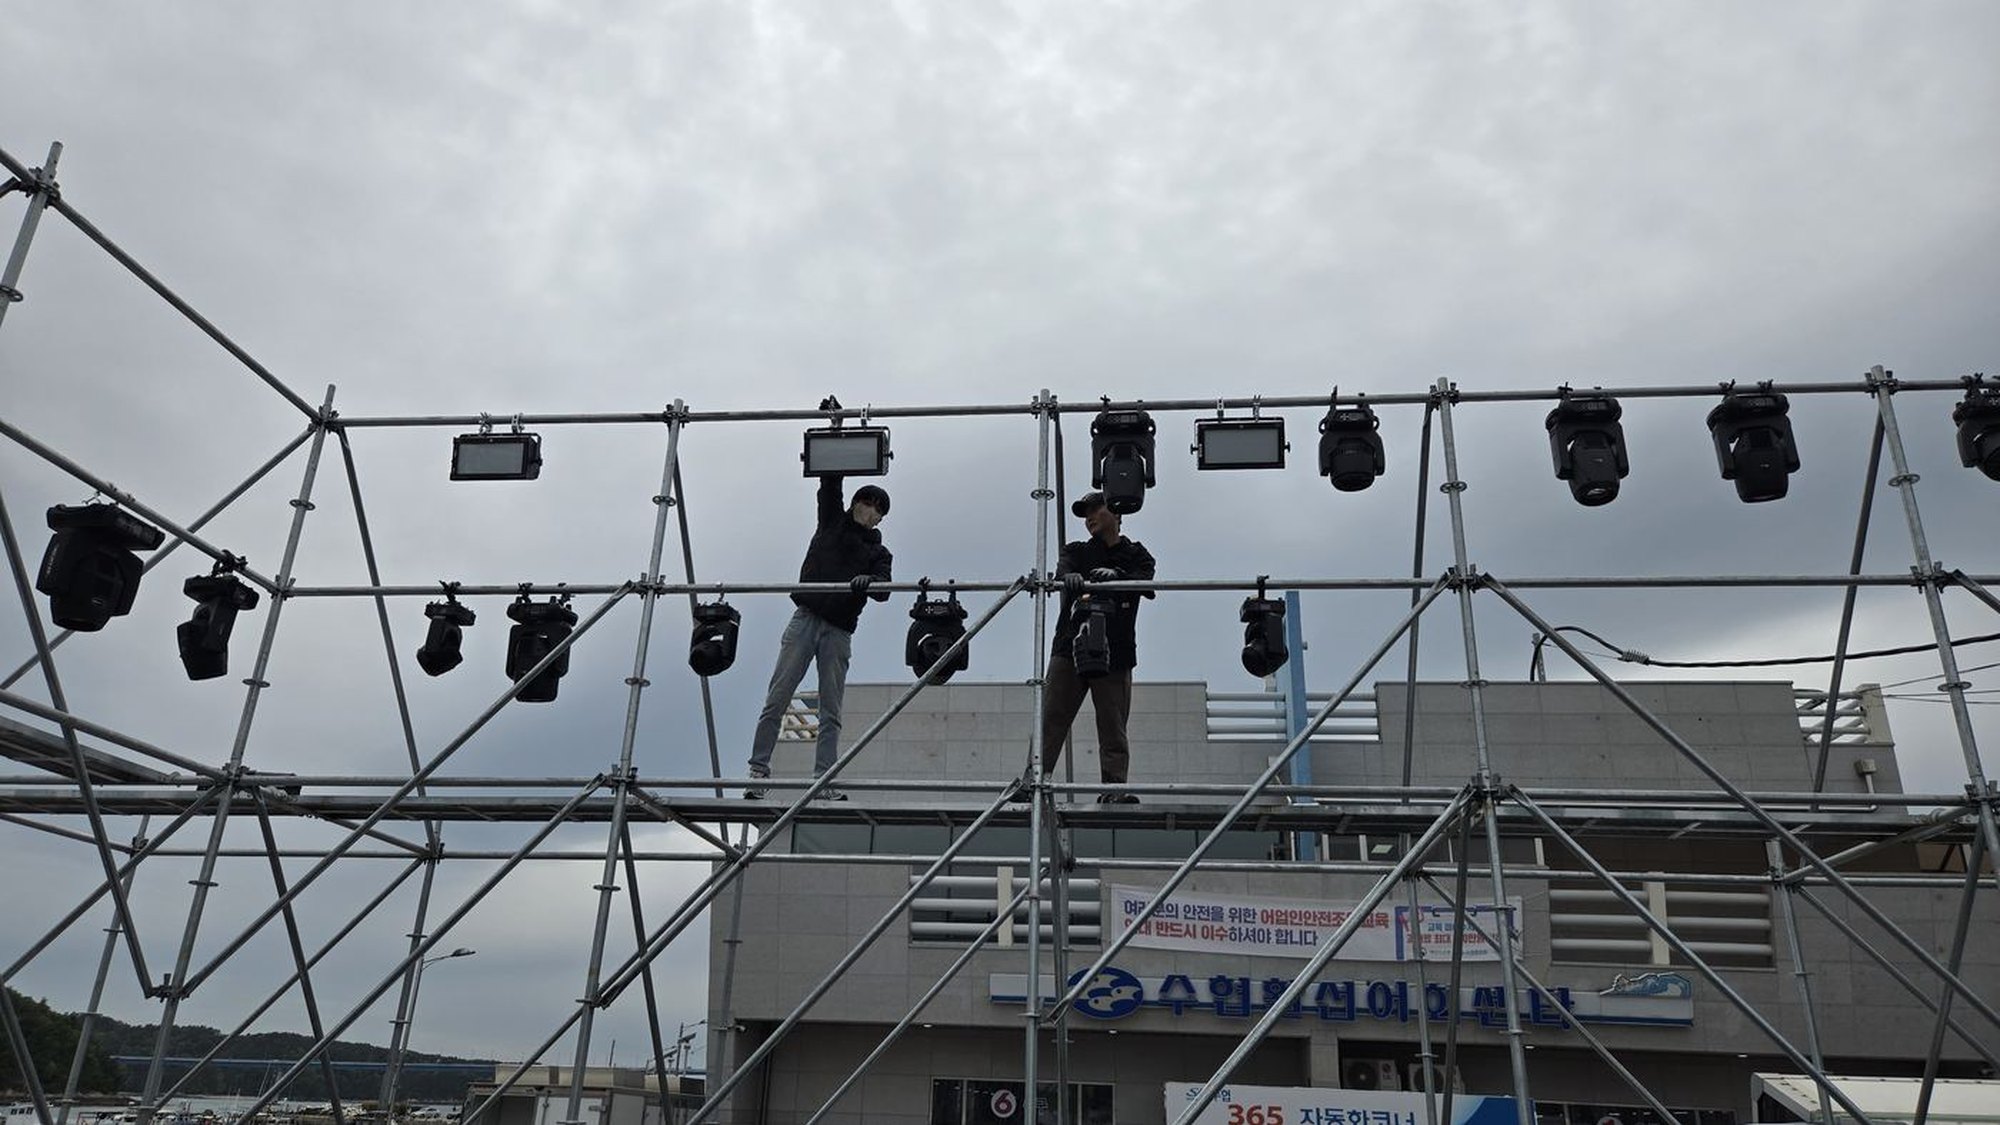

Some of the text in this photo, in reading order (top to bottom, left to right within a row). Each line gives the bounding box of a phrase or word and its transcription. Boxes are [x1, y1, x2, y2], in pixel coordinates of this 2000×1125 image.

[1183, 904, 1225, 922] 안전을
[1228, 907, 1258, 924] 위한
[1155, 921, 1197, 939] 반드시
[1201, 924, 1271, 944] 이수하셔야
[1274, 928, 1319, 946] 합니다
[1228, 1104, 1284, 1125] 365
